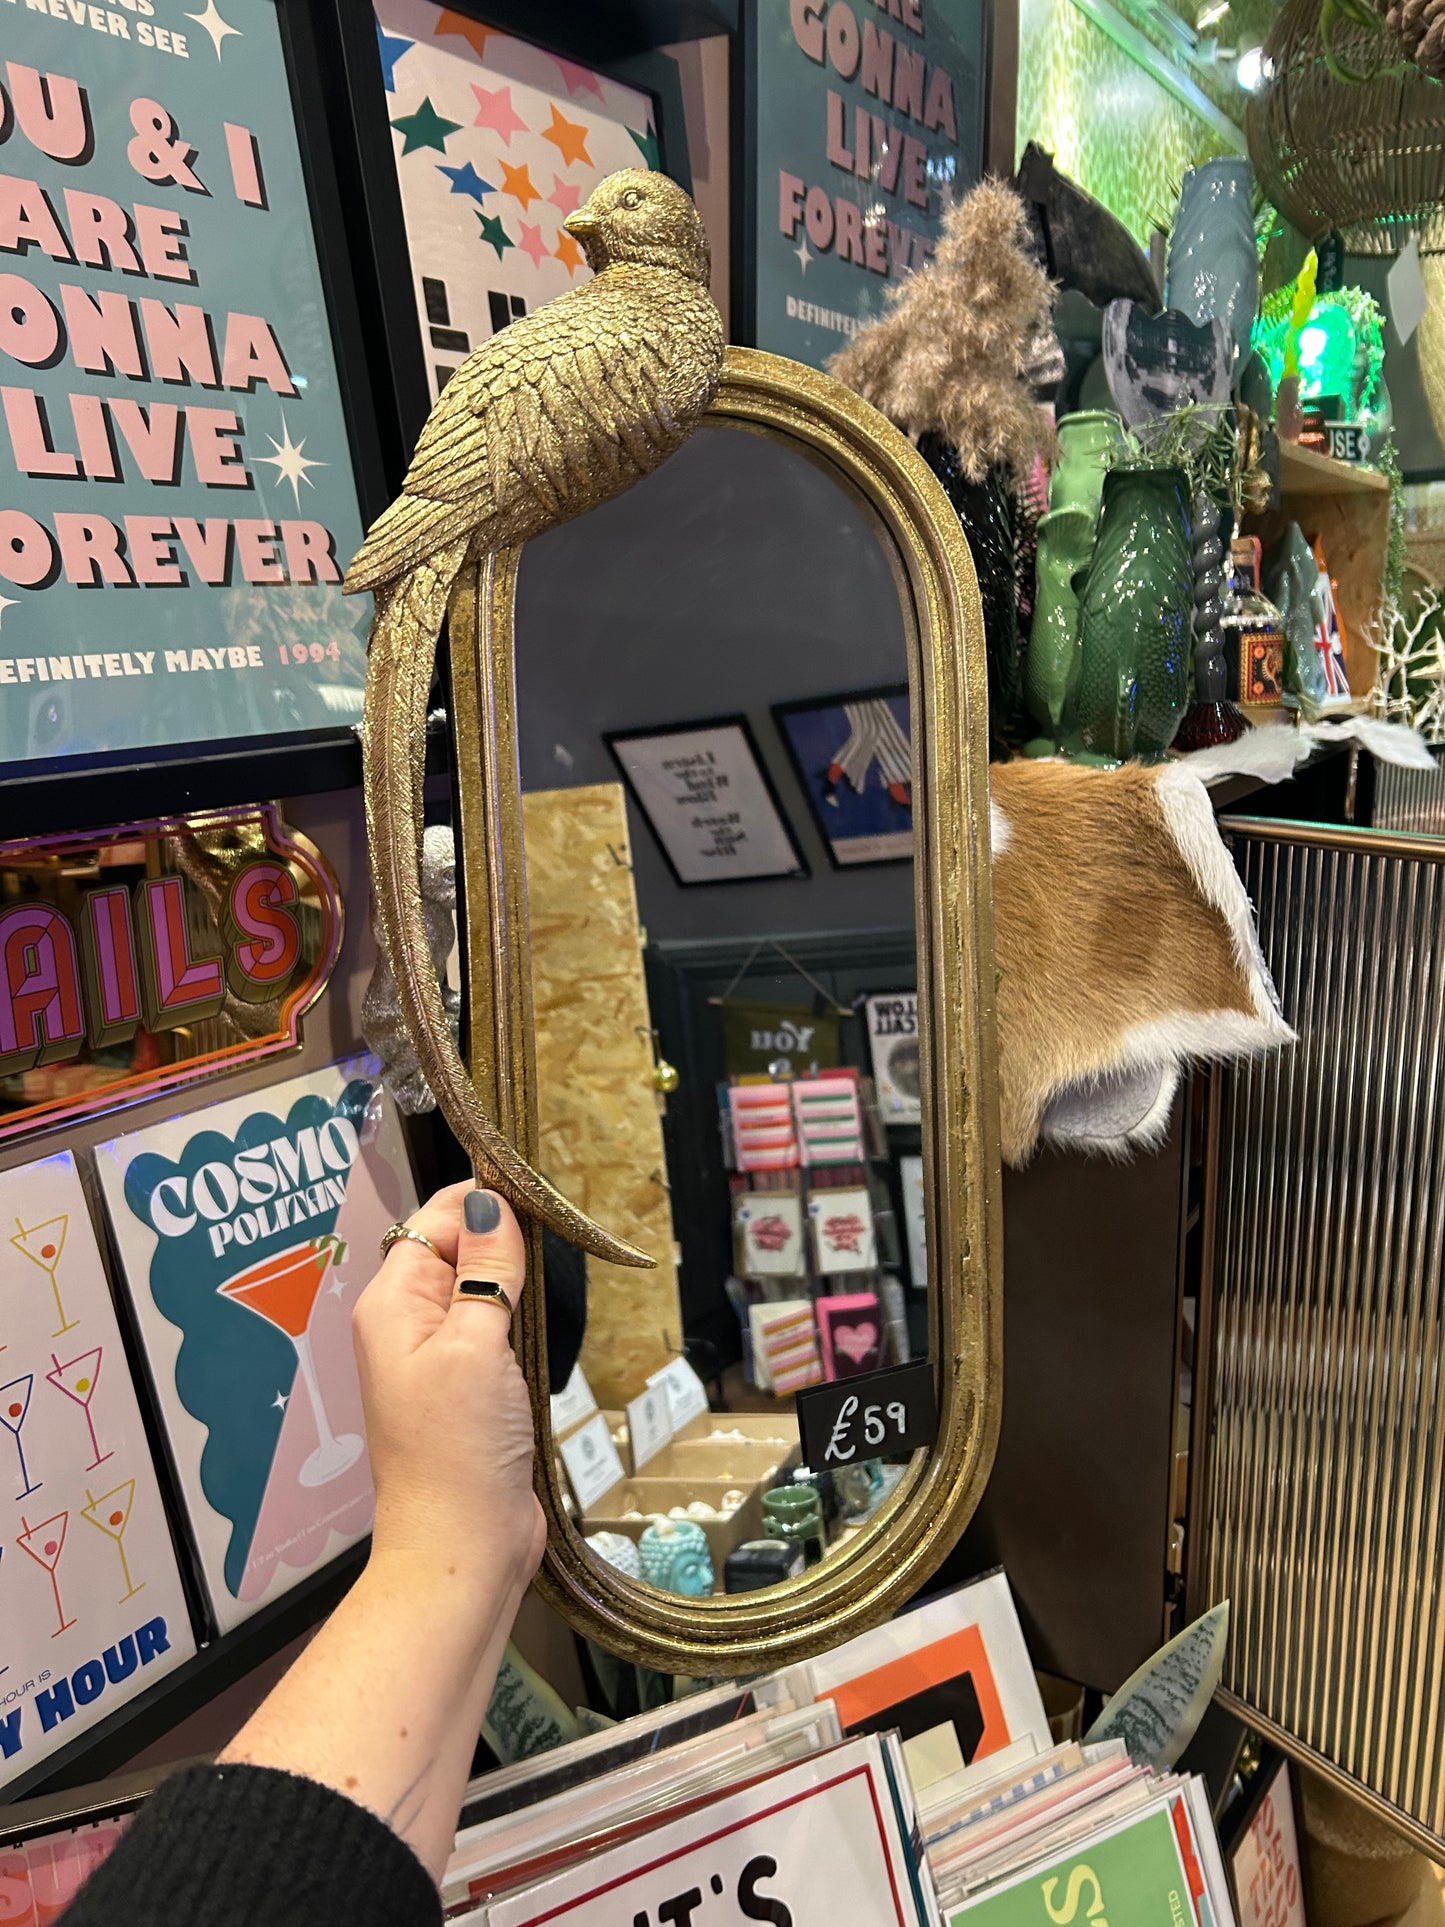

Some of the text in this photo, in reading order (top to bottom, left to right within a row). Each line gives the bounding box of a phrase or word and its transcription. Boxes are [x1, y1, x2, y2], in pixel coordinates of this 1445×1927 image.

[136, 21, 189, 58] SEE
[790, 0, 957, 145] GONNA
[0, 61, 269, 211] U & I
[826, 89, 929, 209] LIVE
[0, 173, 199, 287] ARE
[779, 168, 936, 280] FOREVE
[786, 295, 862, 341] DEFINITEL
[0, 386, 255, 491] LIVE
[0, 510, 347, 590] OREVER
[164, 646, 263, 673] MAYBE
[279, 642, 341, 666] 1994
[0, 861, 303, 1077] AILS
[150, 1116, 360, 1238] COSMO
[824, 1395, 906, 1461] £59
[34, 1616, 171, 1734] HOUR
[38, 1669, 52, 1683] IS
[633, 1855, 793, 1927] T'S
